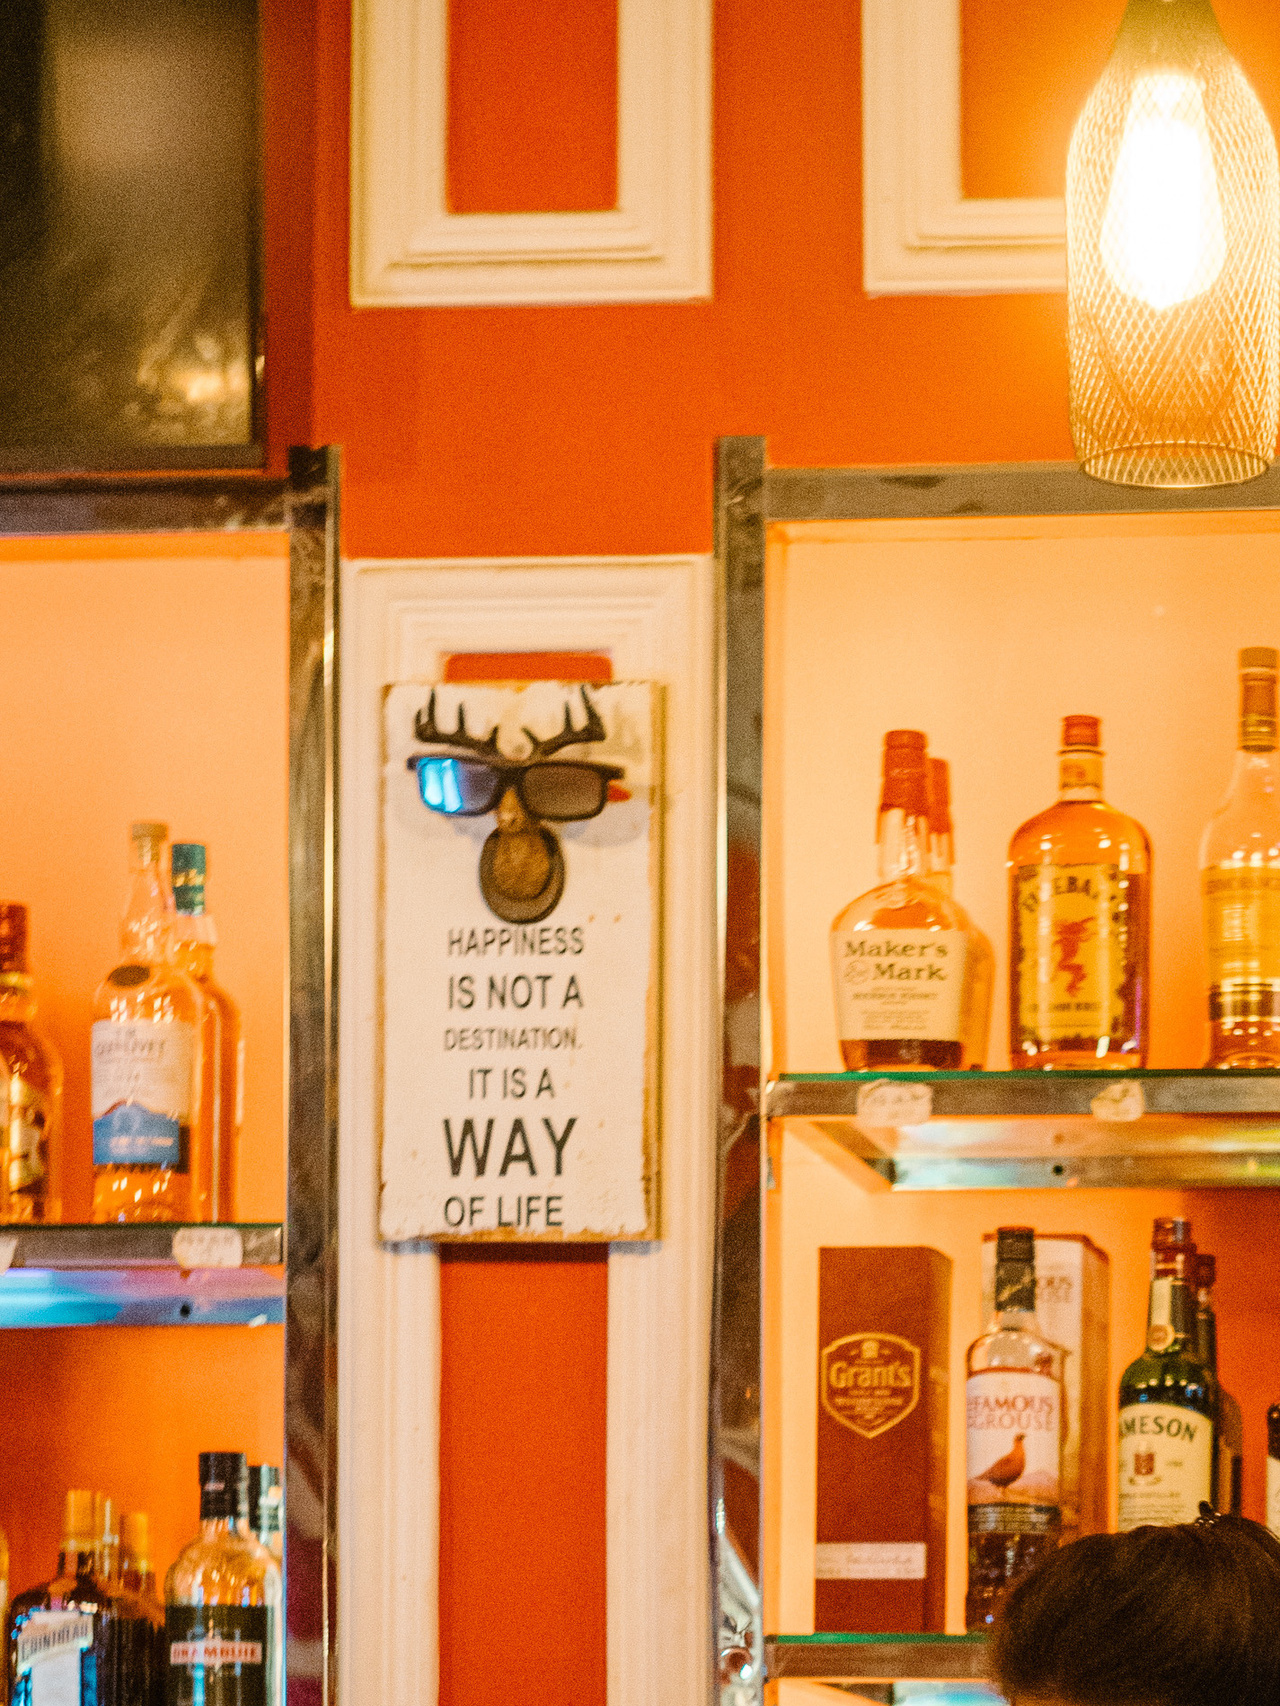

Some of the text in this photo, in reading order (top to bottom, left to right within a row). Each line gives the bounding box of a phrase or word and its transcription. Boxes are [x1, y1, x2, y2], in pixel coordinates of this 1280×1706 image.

[447, 926, 584, 957] HAPPINESS
[873, 962, 946, 981] Mark
[447, 975, 584, 1009] IS NOT A
[443, 1028, 583, 1051] DESTINATION.
[468, 1068, 555, 1099] IT IS A
[443, 1118, 578, 1177] WAY
[444, 1196, 563, 1227] OF LIFE
[974, 1394, 1053, 1414] FAMOUS
[1121, 1415, 1198, 1442] MESON
